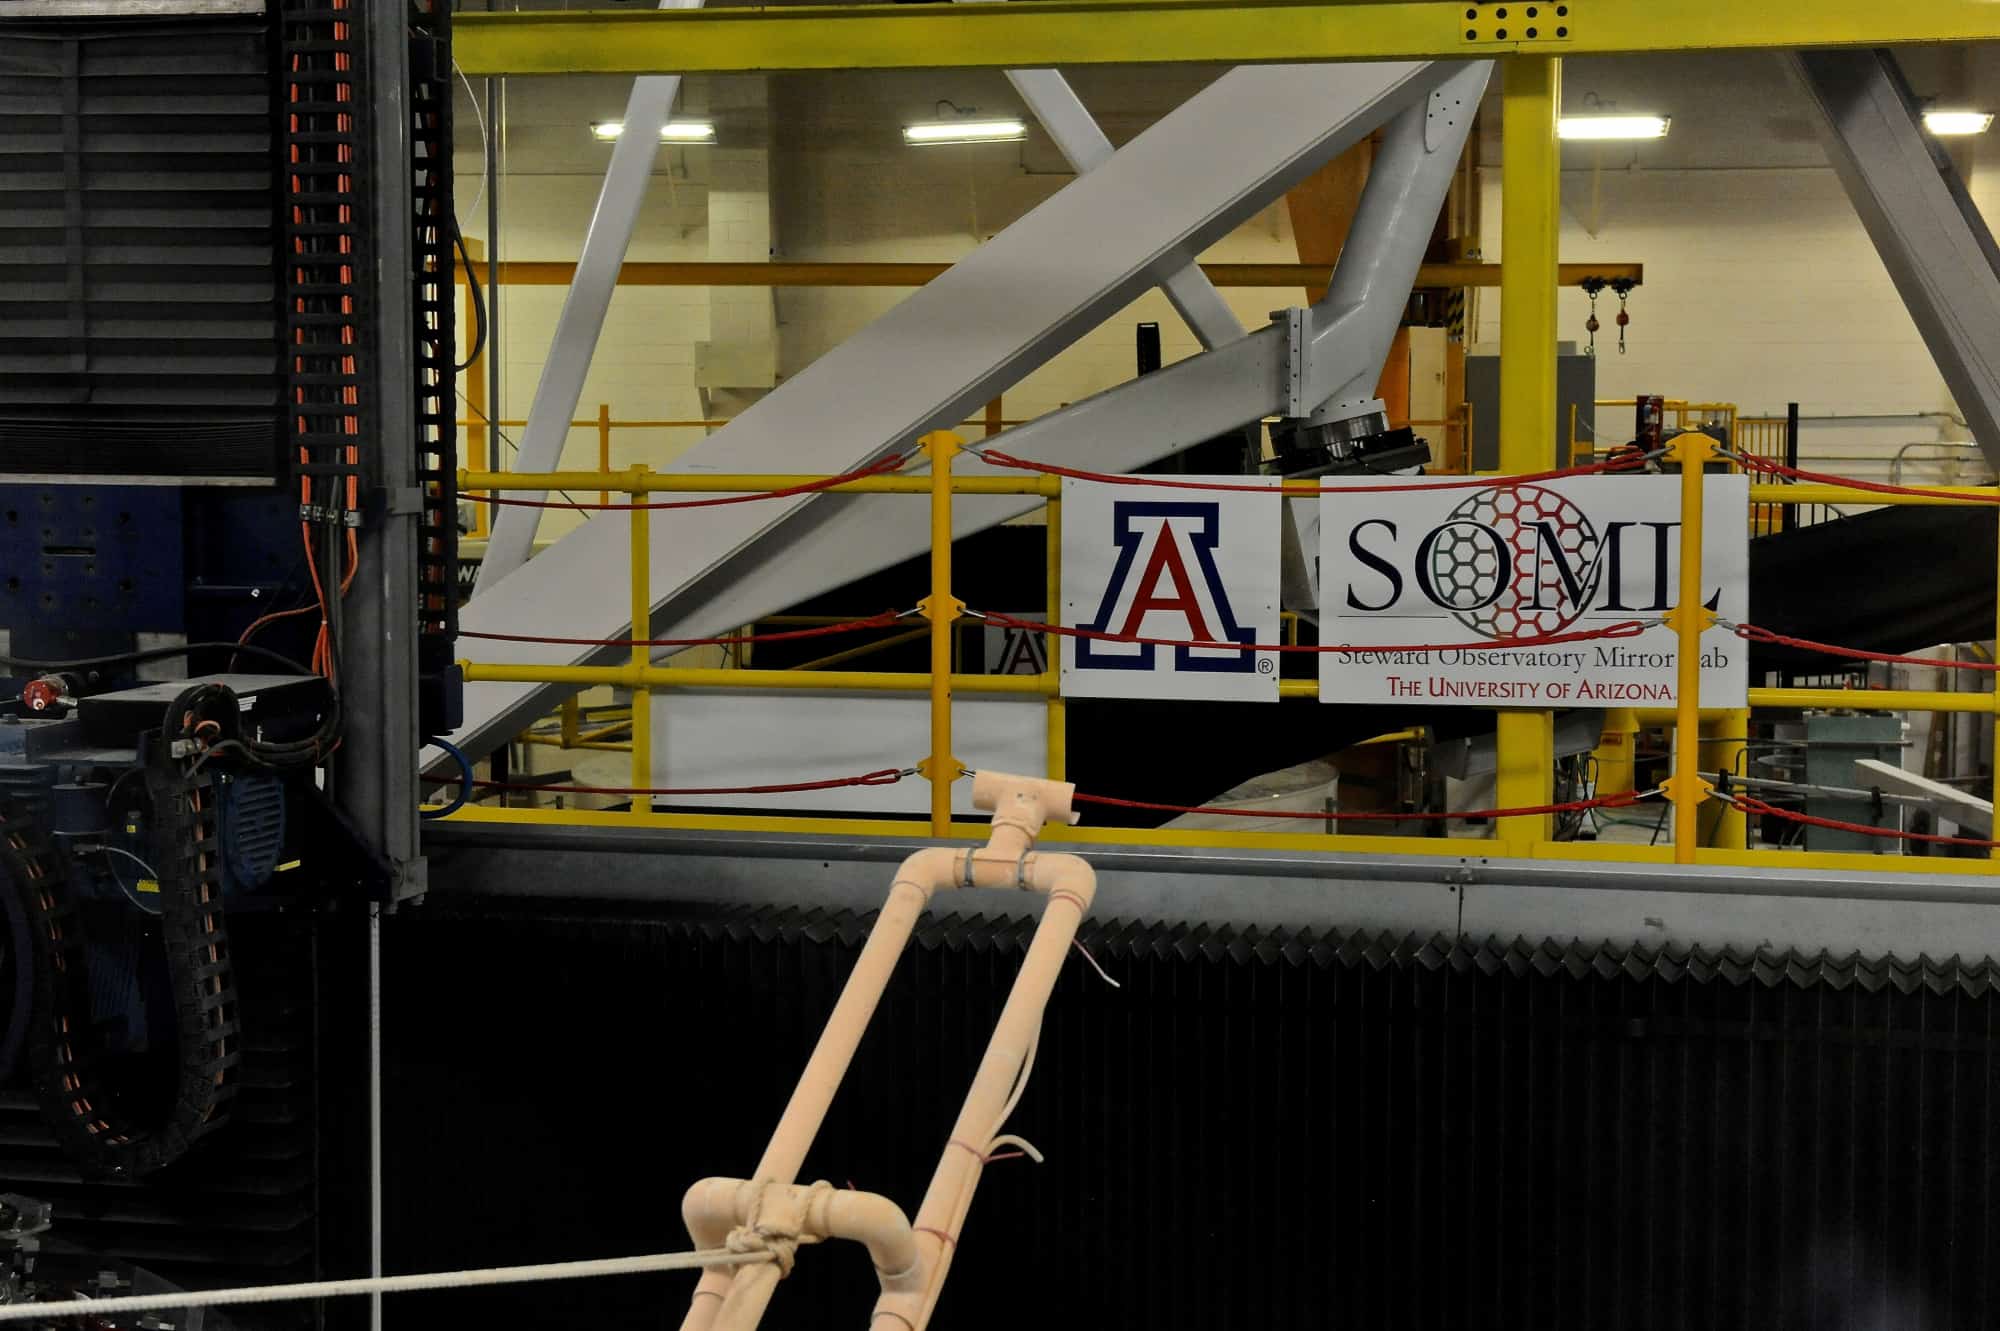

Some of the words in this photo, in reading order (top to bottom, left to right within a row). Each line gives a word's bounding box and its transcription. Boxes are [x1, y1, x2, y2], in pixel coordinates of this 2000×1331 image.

[1075, 501, 1257, 673] A
[1346, 518, 1721, 613] SOML
[1338, 644, 1430, 666] Steward
[1439, 648, 1587, 674] Observatory
[1593, 646, 1675, 669] Mirror
[1700, 646, 1729, 669] ab
[1386, 676, 1423, 697] THE
[1429, 677, 1541, 698] UNIVERSITY
[1546, 683, 1572, 699] OF
